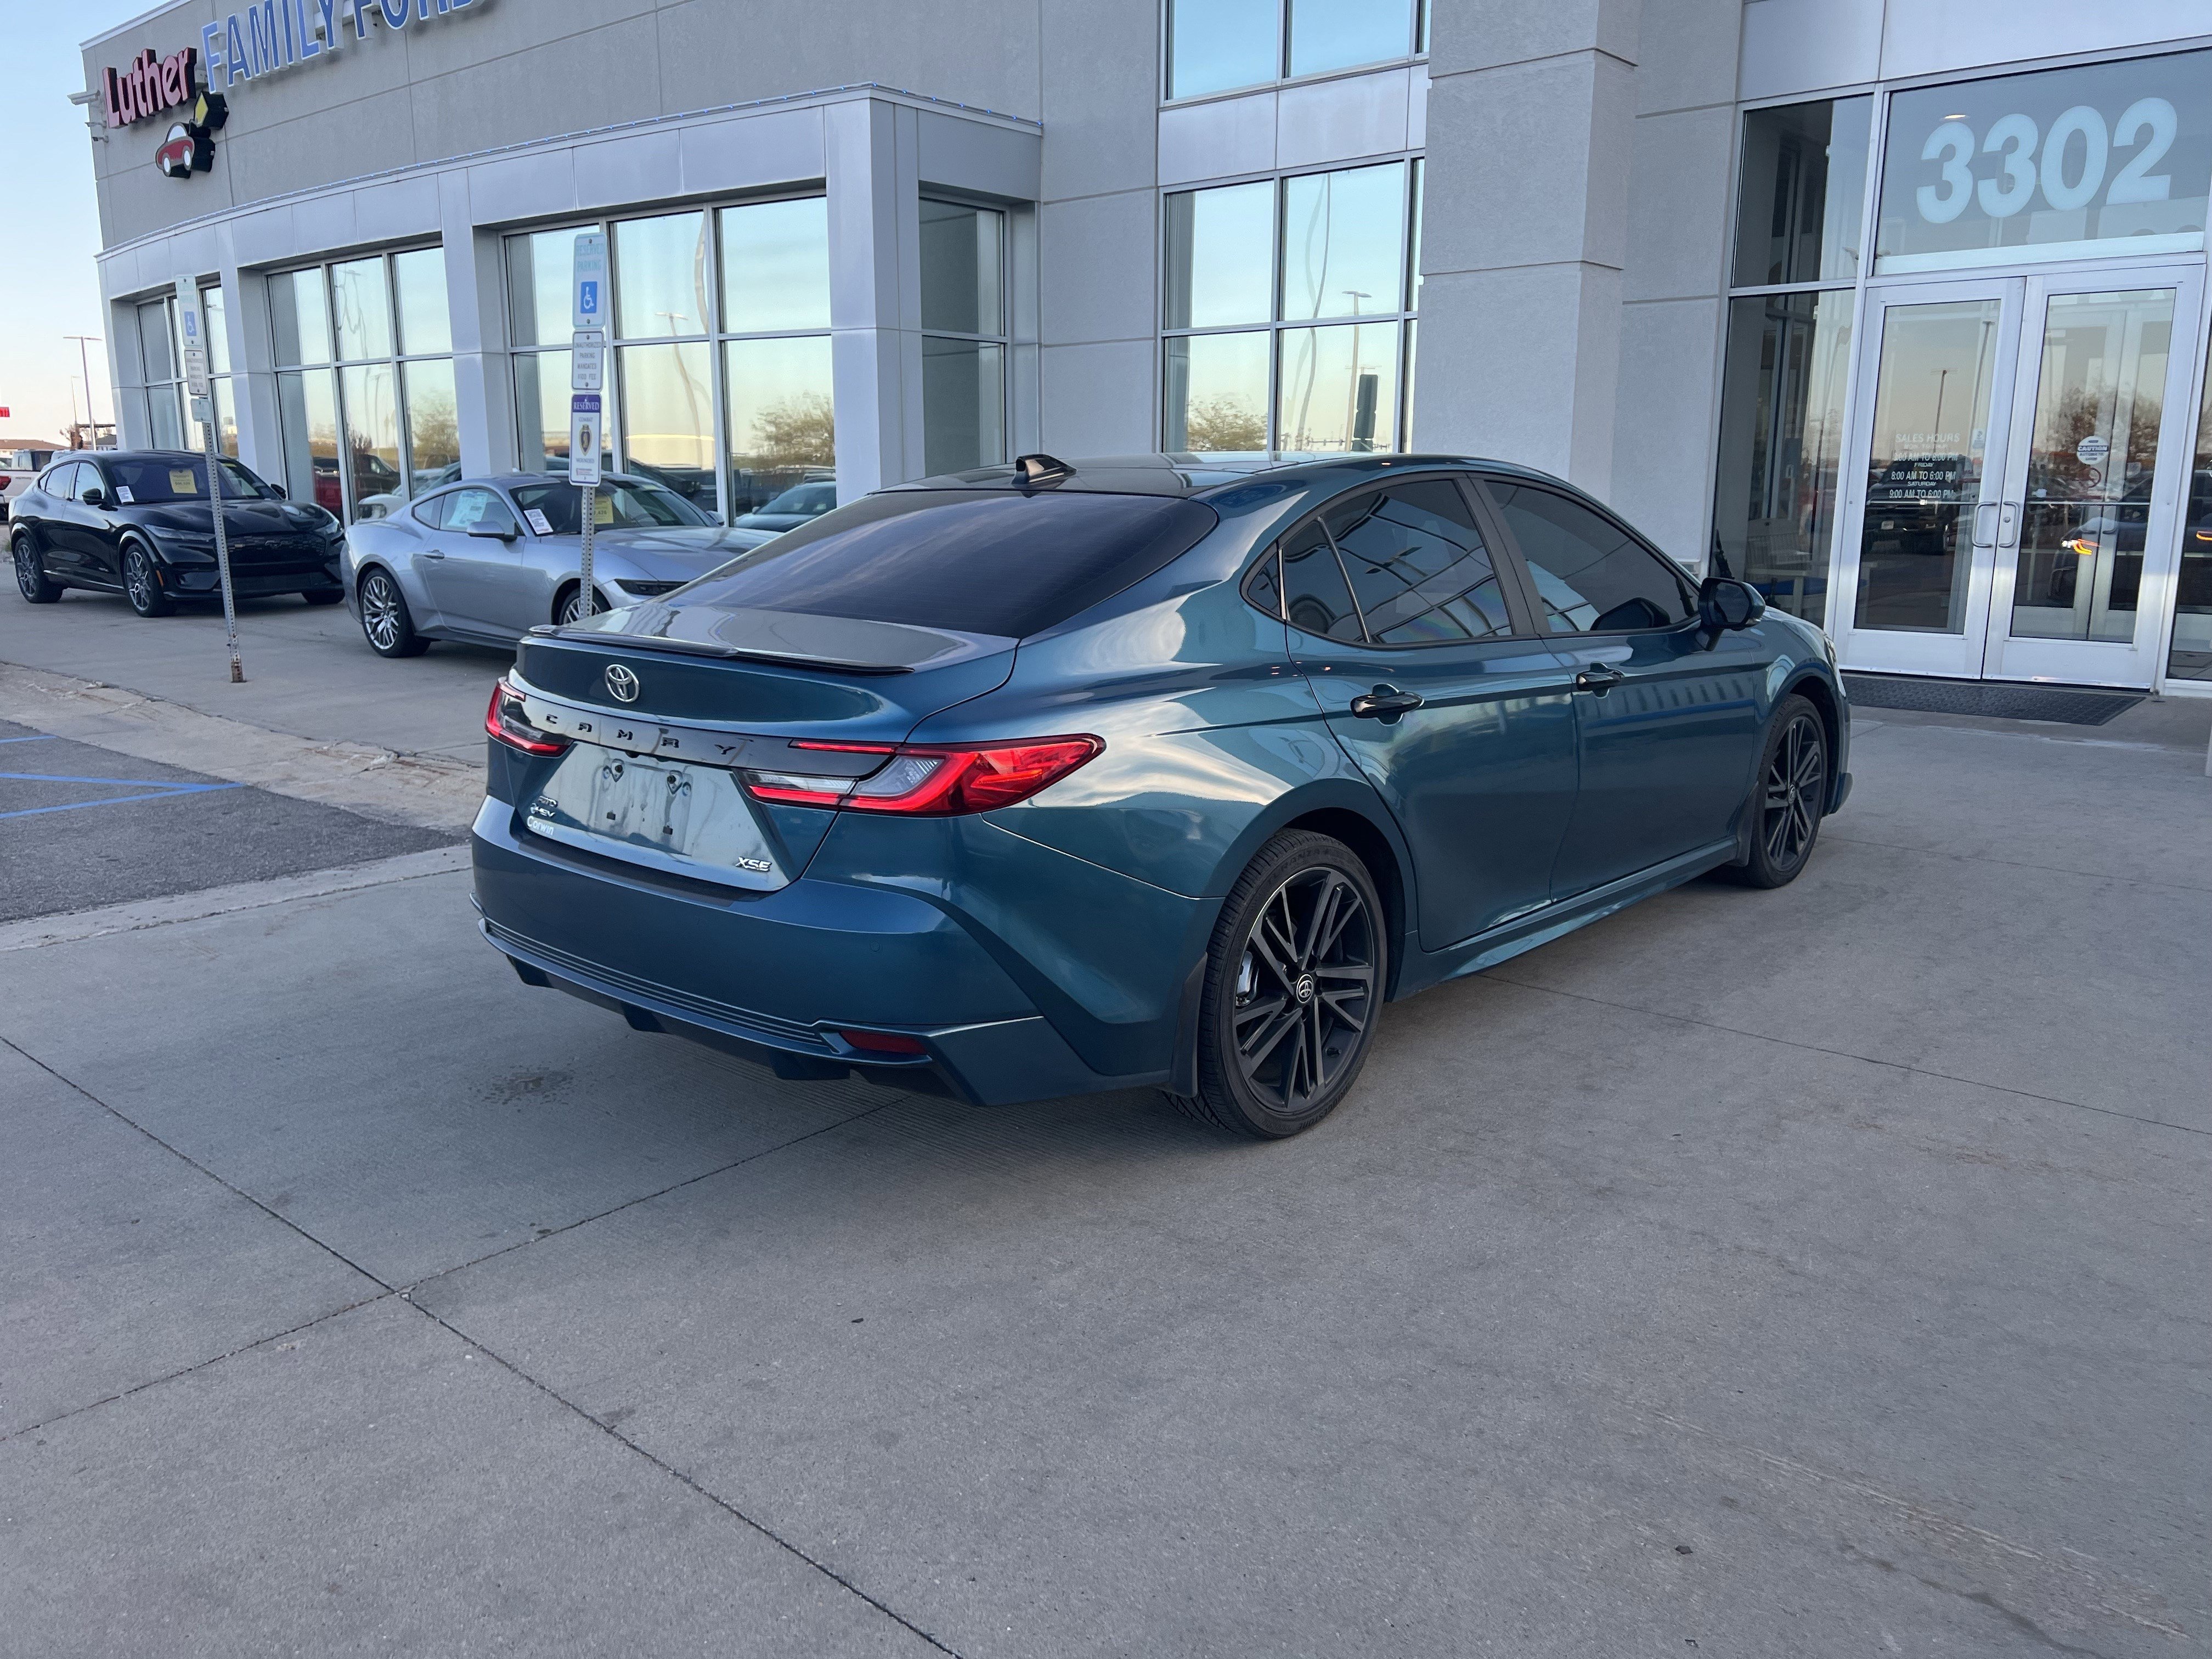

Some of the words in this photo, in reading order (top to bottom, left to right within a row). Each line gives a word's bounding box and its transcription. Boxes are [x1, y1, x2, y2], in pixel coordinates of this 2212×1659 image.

[103, 47, 189, 128] Luther
[201, 0, 336, 94] FAMILY
[1916, 97, 2177, 223] 3302
[576, 242, 604, 257] RESERVED
[577, 259, 601, 272] PARKING
[573, 402, 600, 410] RESERVED
[1895, 433, 1925, 443] SALES
[1927, 433, 1961, 442] HOURS
[1891, 471, 1904, 480] 8:00
[1906, 471, 1917, 480] AM
[1918, 471, 1928, 480] TO
[1929, 471, 1944, 480] 6:00
[1945, 471, 1956, 480] PM
[1889, 489, 1903, 499] 9:00
[1904, 489, 1915, 498] AM
[1917, 489, 1926, 499] TO
[1927, 489, 1942, 499] 6:00
[1943, 489, 1955, 499] PM
[546, 714, 736, 755] CAMRY
[527, 815, 554, 836] Corwin
[735, 856, 772, 872] XSE
